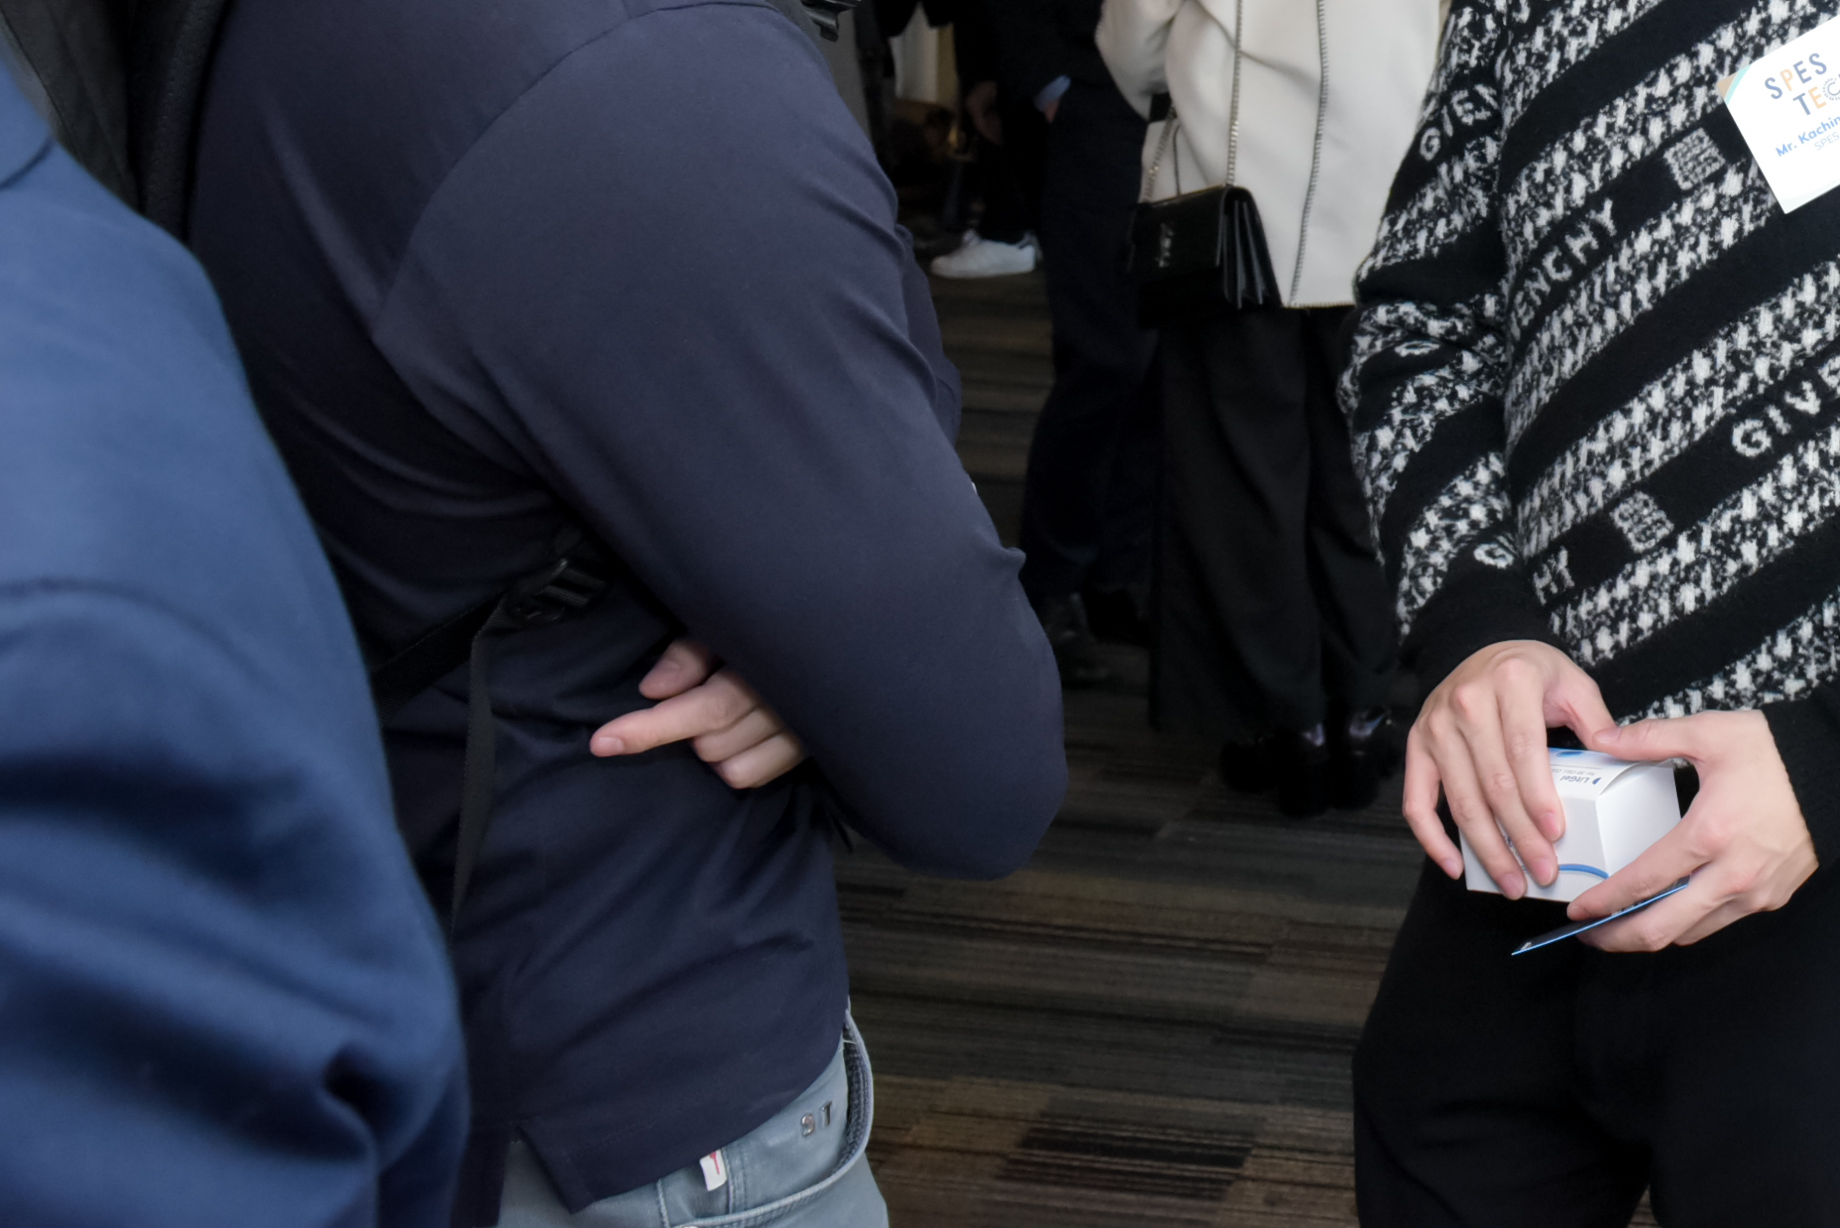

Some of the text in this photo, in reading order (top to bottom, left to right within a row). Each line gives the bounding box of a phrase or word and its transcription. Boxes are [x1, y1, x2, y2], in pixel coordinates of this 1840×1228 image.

[1764, 52, 1827, 100] SPES
[1775, 142, 1798, 158] Mr.
[1813, 132, 1840, 152] SPES
